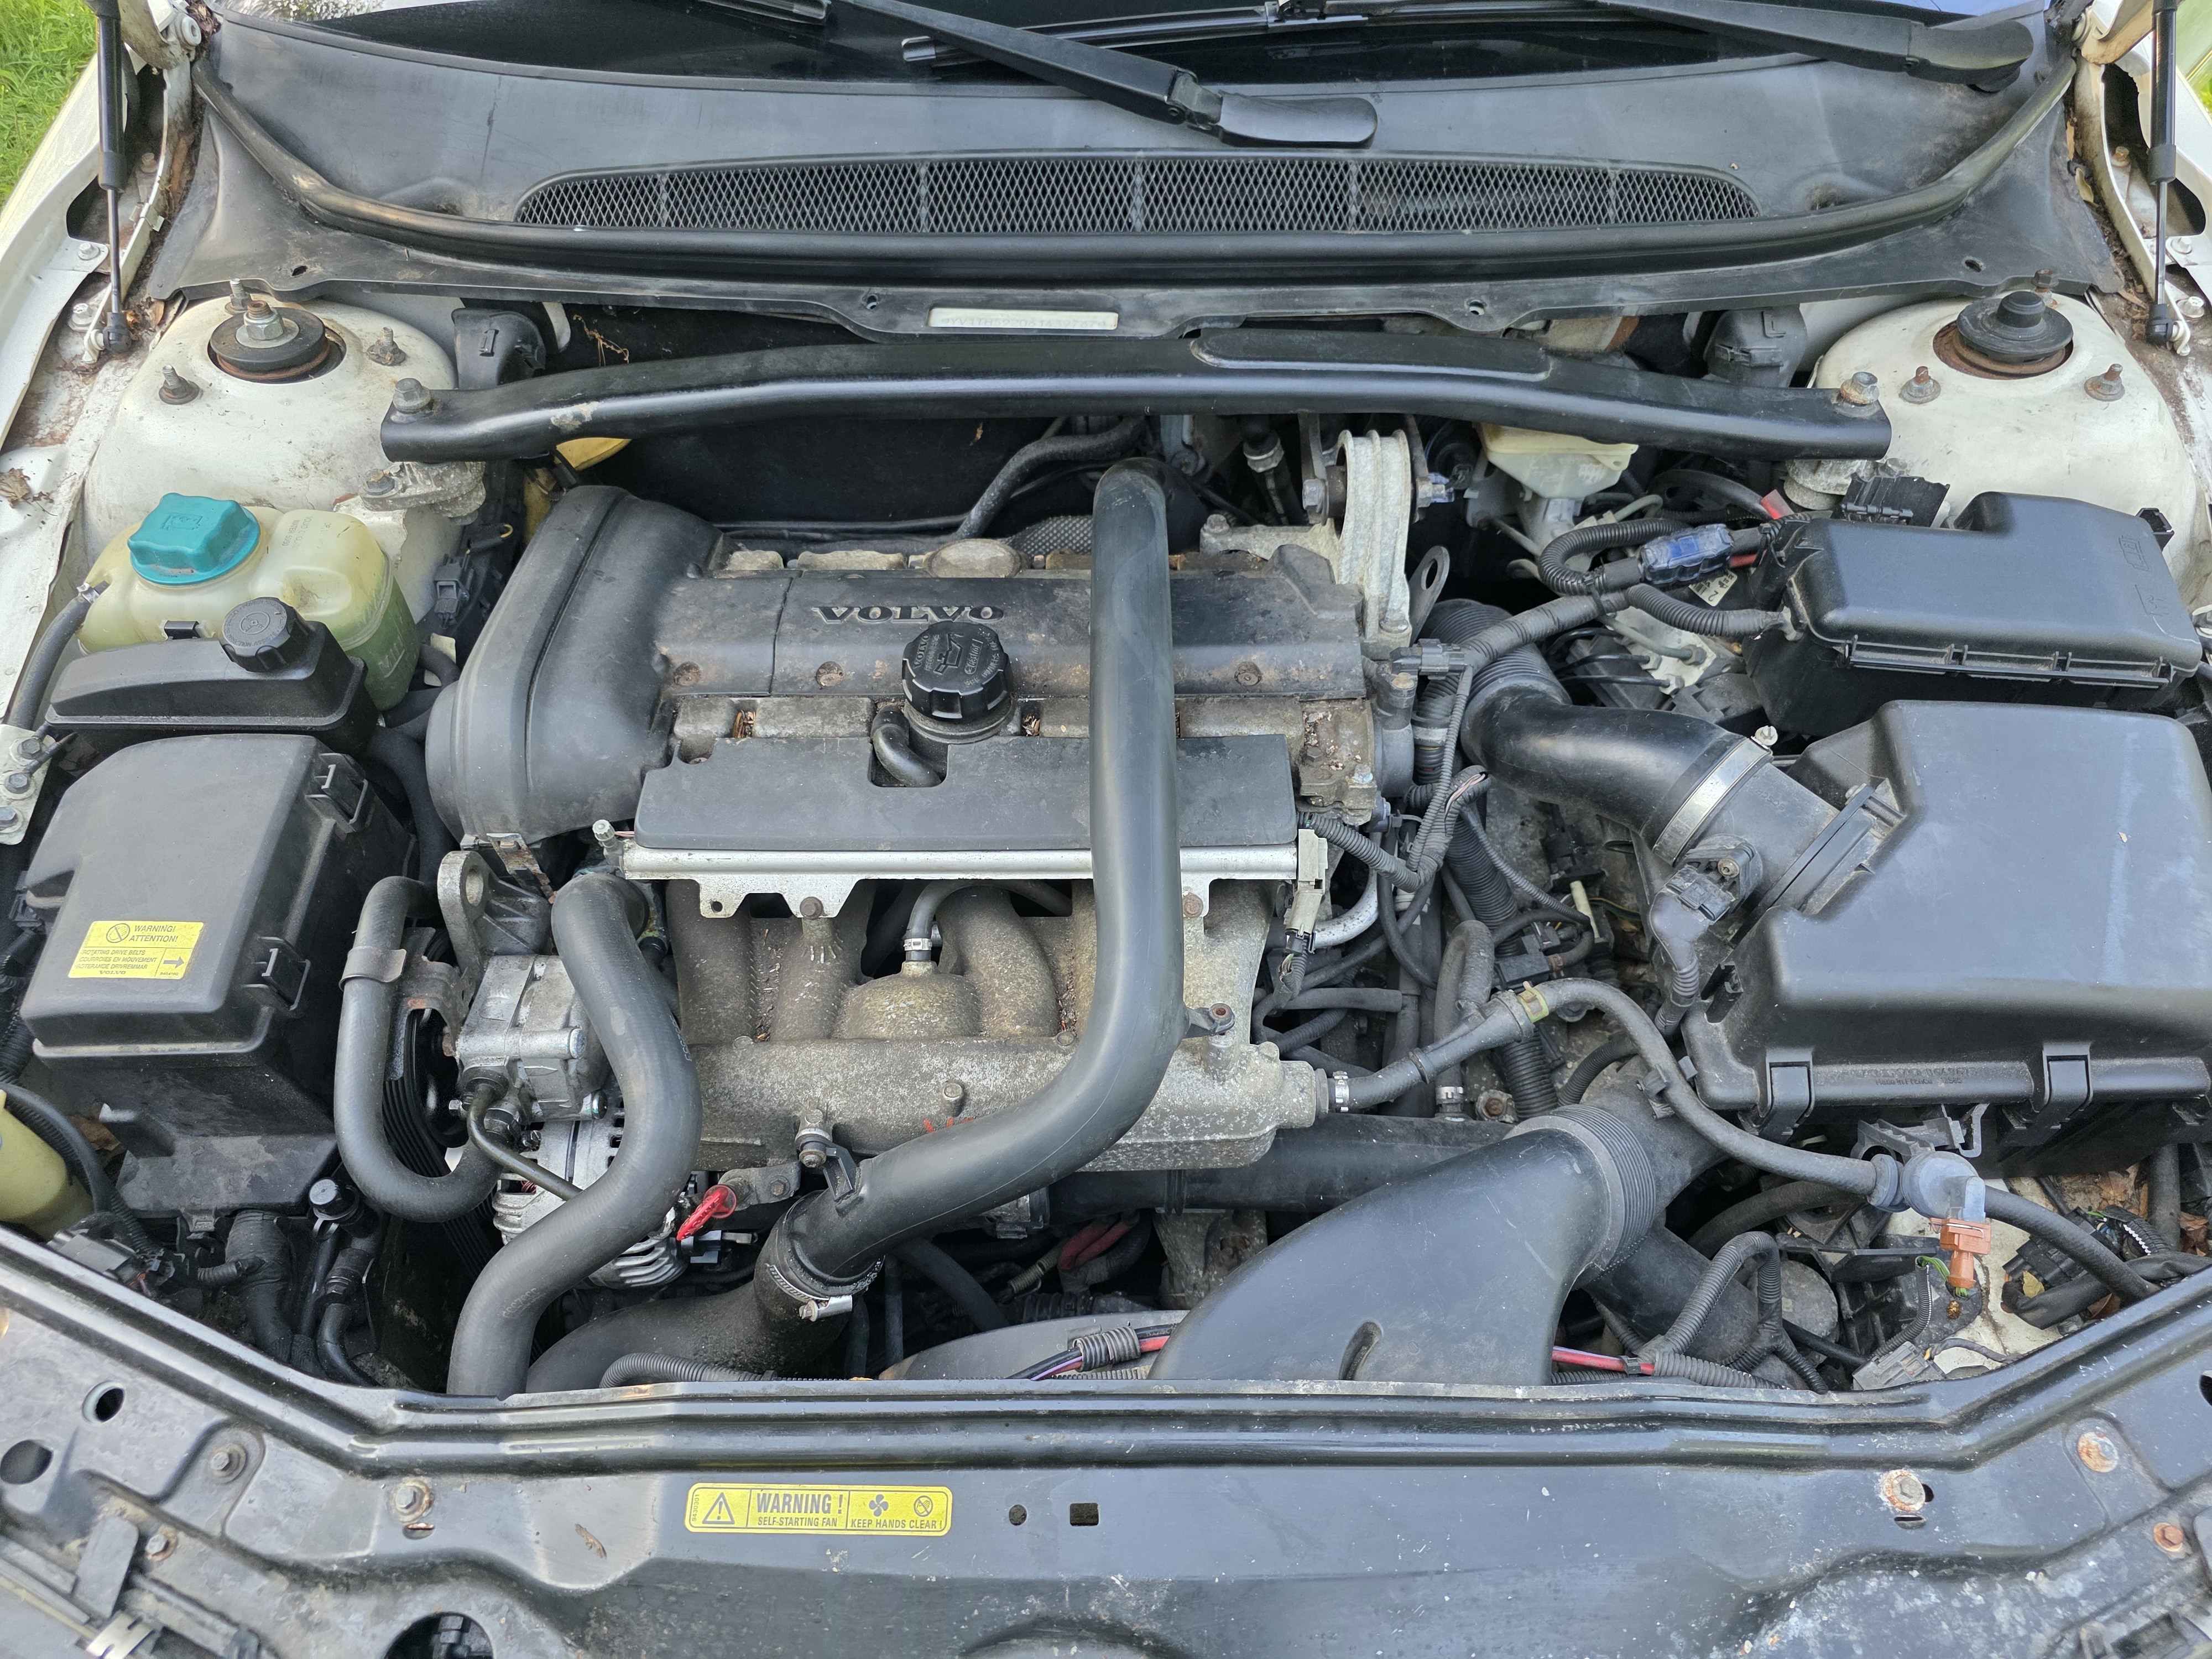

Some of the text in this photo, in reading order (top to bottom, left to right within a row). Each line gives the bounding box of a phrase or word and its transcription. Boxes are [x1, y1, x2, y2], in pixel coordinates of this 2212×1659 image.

[810, 606, 1004, 623] VOLVO
[914, 634, 930, 669] VOLVO
[757, 1493, 843, 1514] WARNING !
[758, 1517, 837, 1527] SELF-STARTING FAN
[851, 1519, 873, 1528] KEEP
[875, 1519, 906, 1528] HANDS
[909, 1520, 937, 1529] CLEAR
